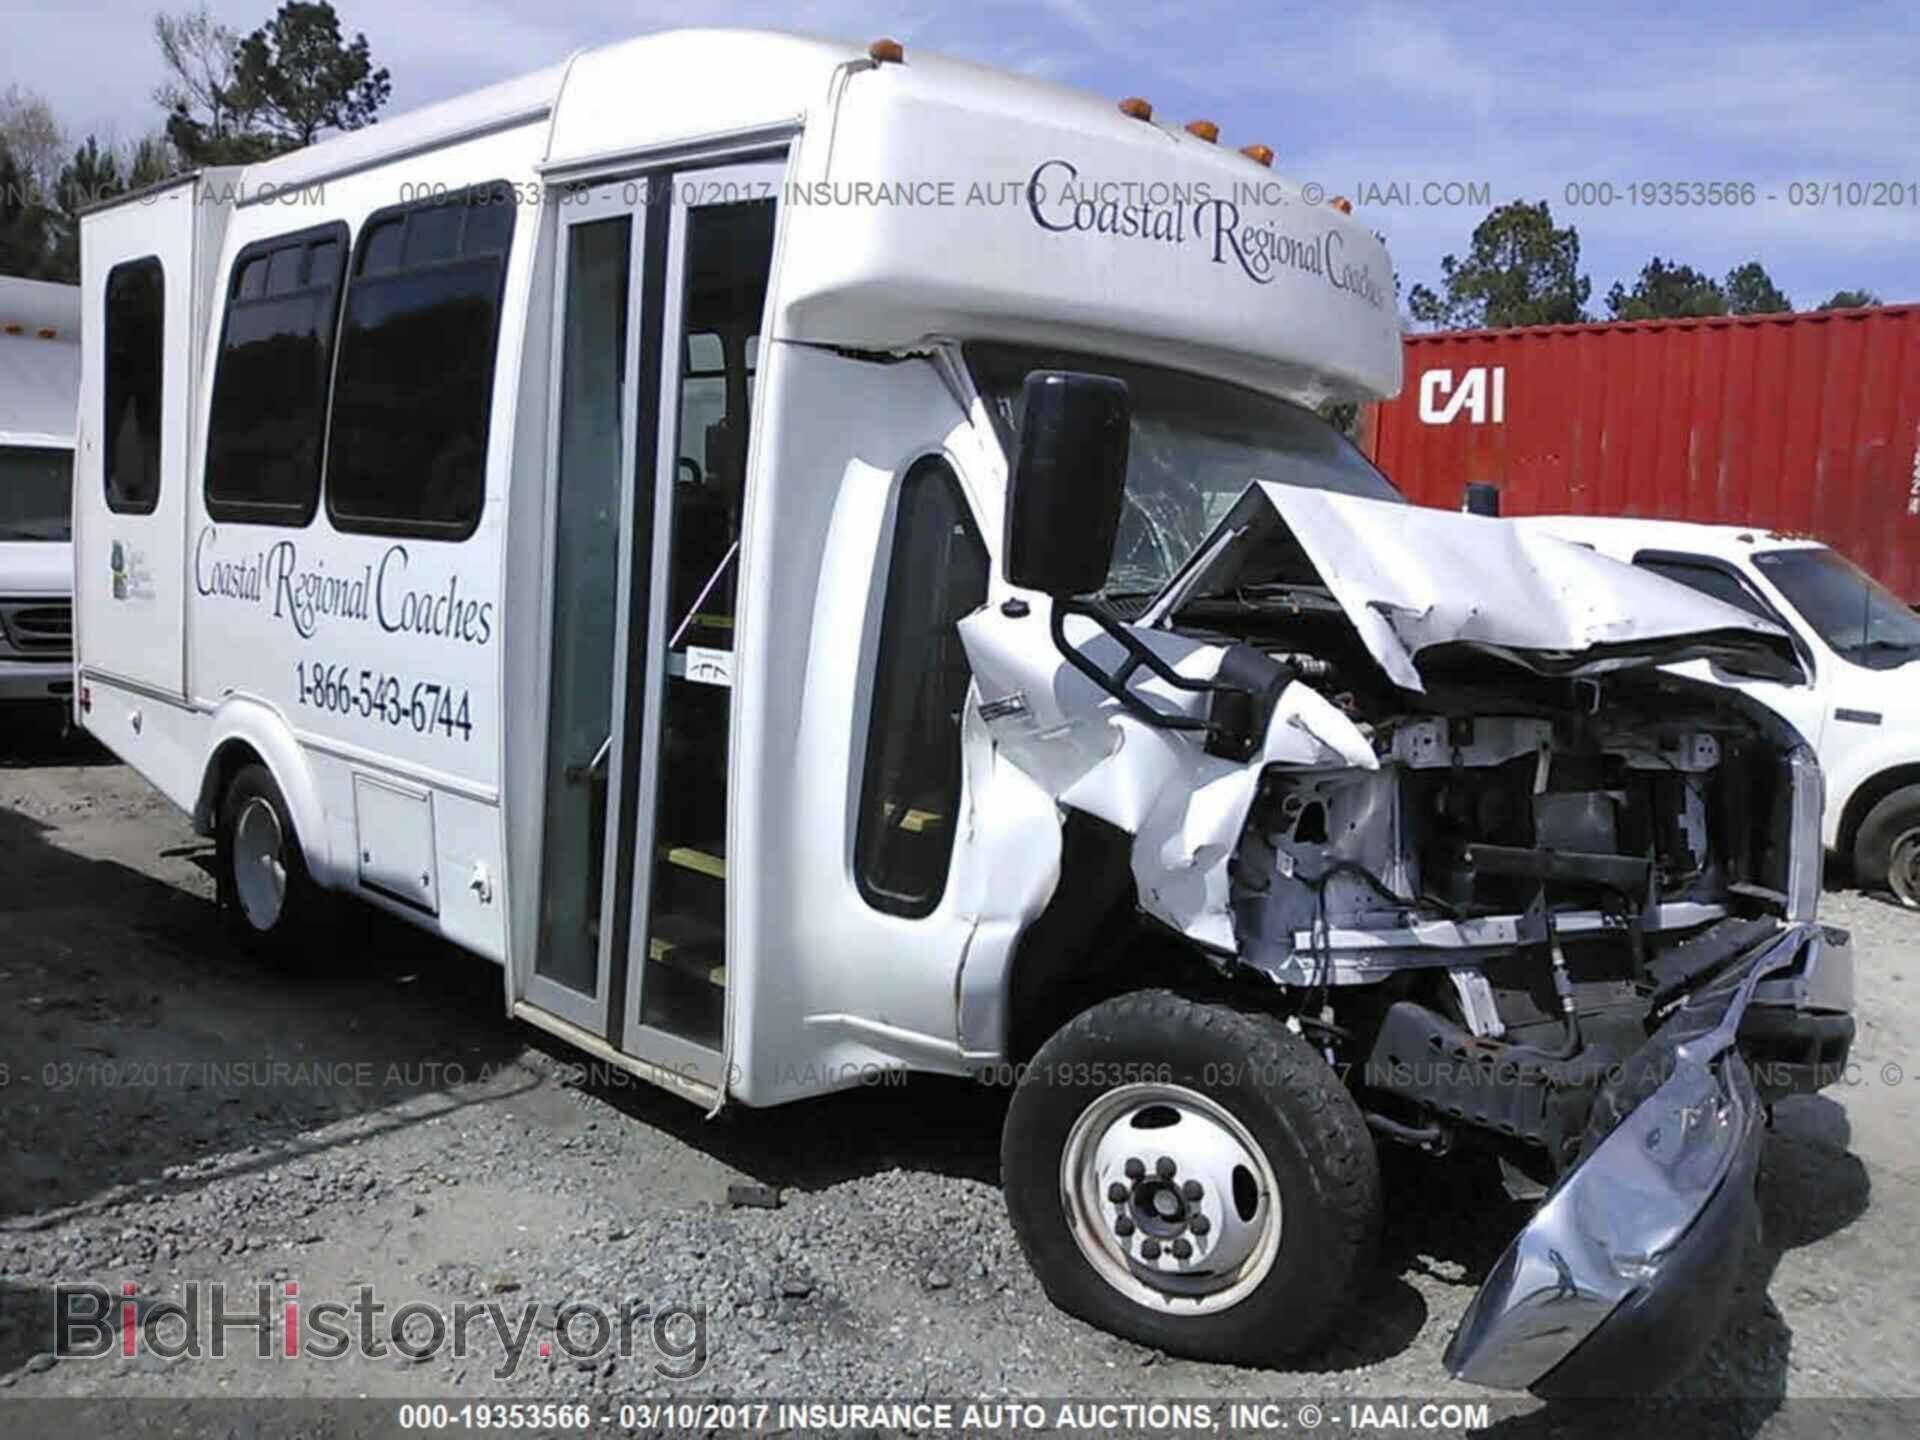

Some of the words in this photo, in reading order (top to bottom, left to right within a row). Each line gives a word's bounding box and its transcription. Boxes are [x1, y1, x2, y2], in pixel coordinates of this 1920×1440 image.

[1028, 160, 1184, 243] Coastal
[1193, 198, 1324, 285] Regional
[1419, 366, 1505, 424] CAI
[195, 525, 262, 603] Coastal
[265, 540, 373, 640] Regional
[376, 544, 493, 646] Coaches
[296, 660, 473, 743] 1-866-543-6744
